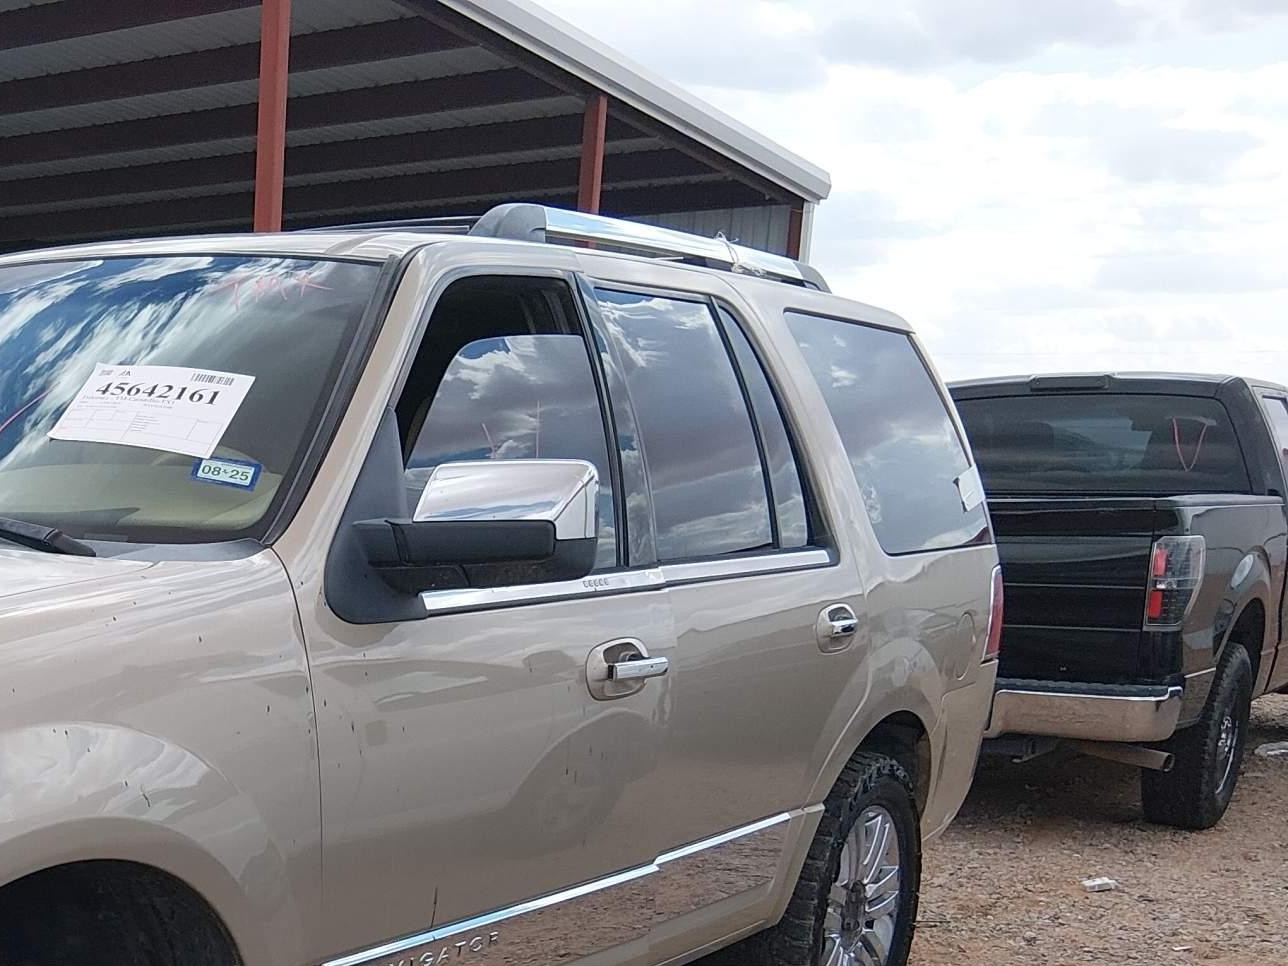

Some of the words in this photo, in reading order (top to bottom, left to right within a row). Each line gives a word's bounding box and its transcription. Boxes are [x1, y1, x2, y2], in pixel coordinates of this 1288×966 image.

[95, 381, 222, 406] 45642161
[201, 464, 222, 477] 08
[229, 469, 251, 482] 25
